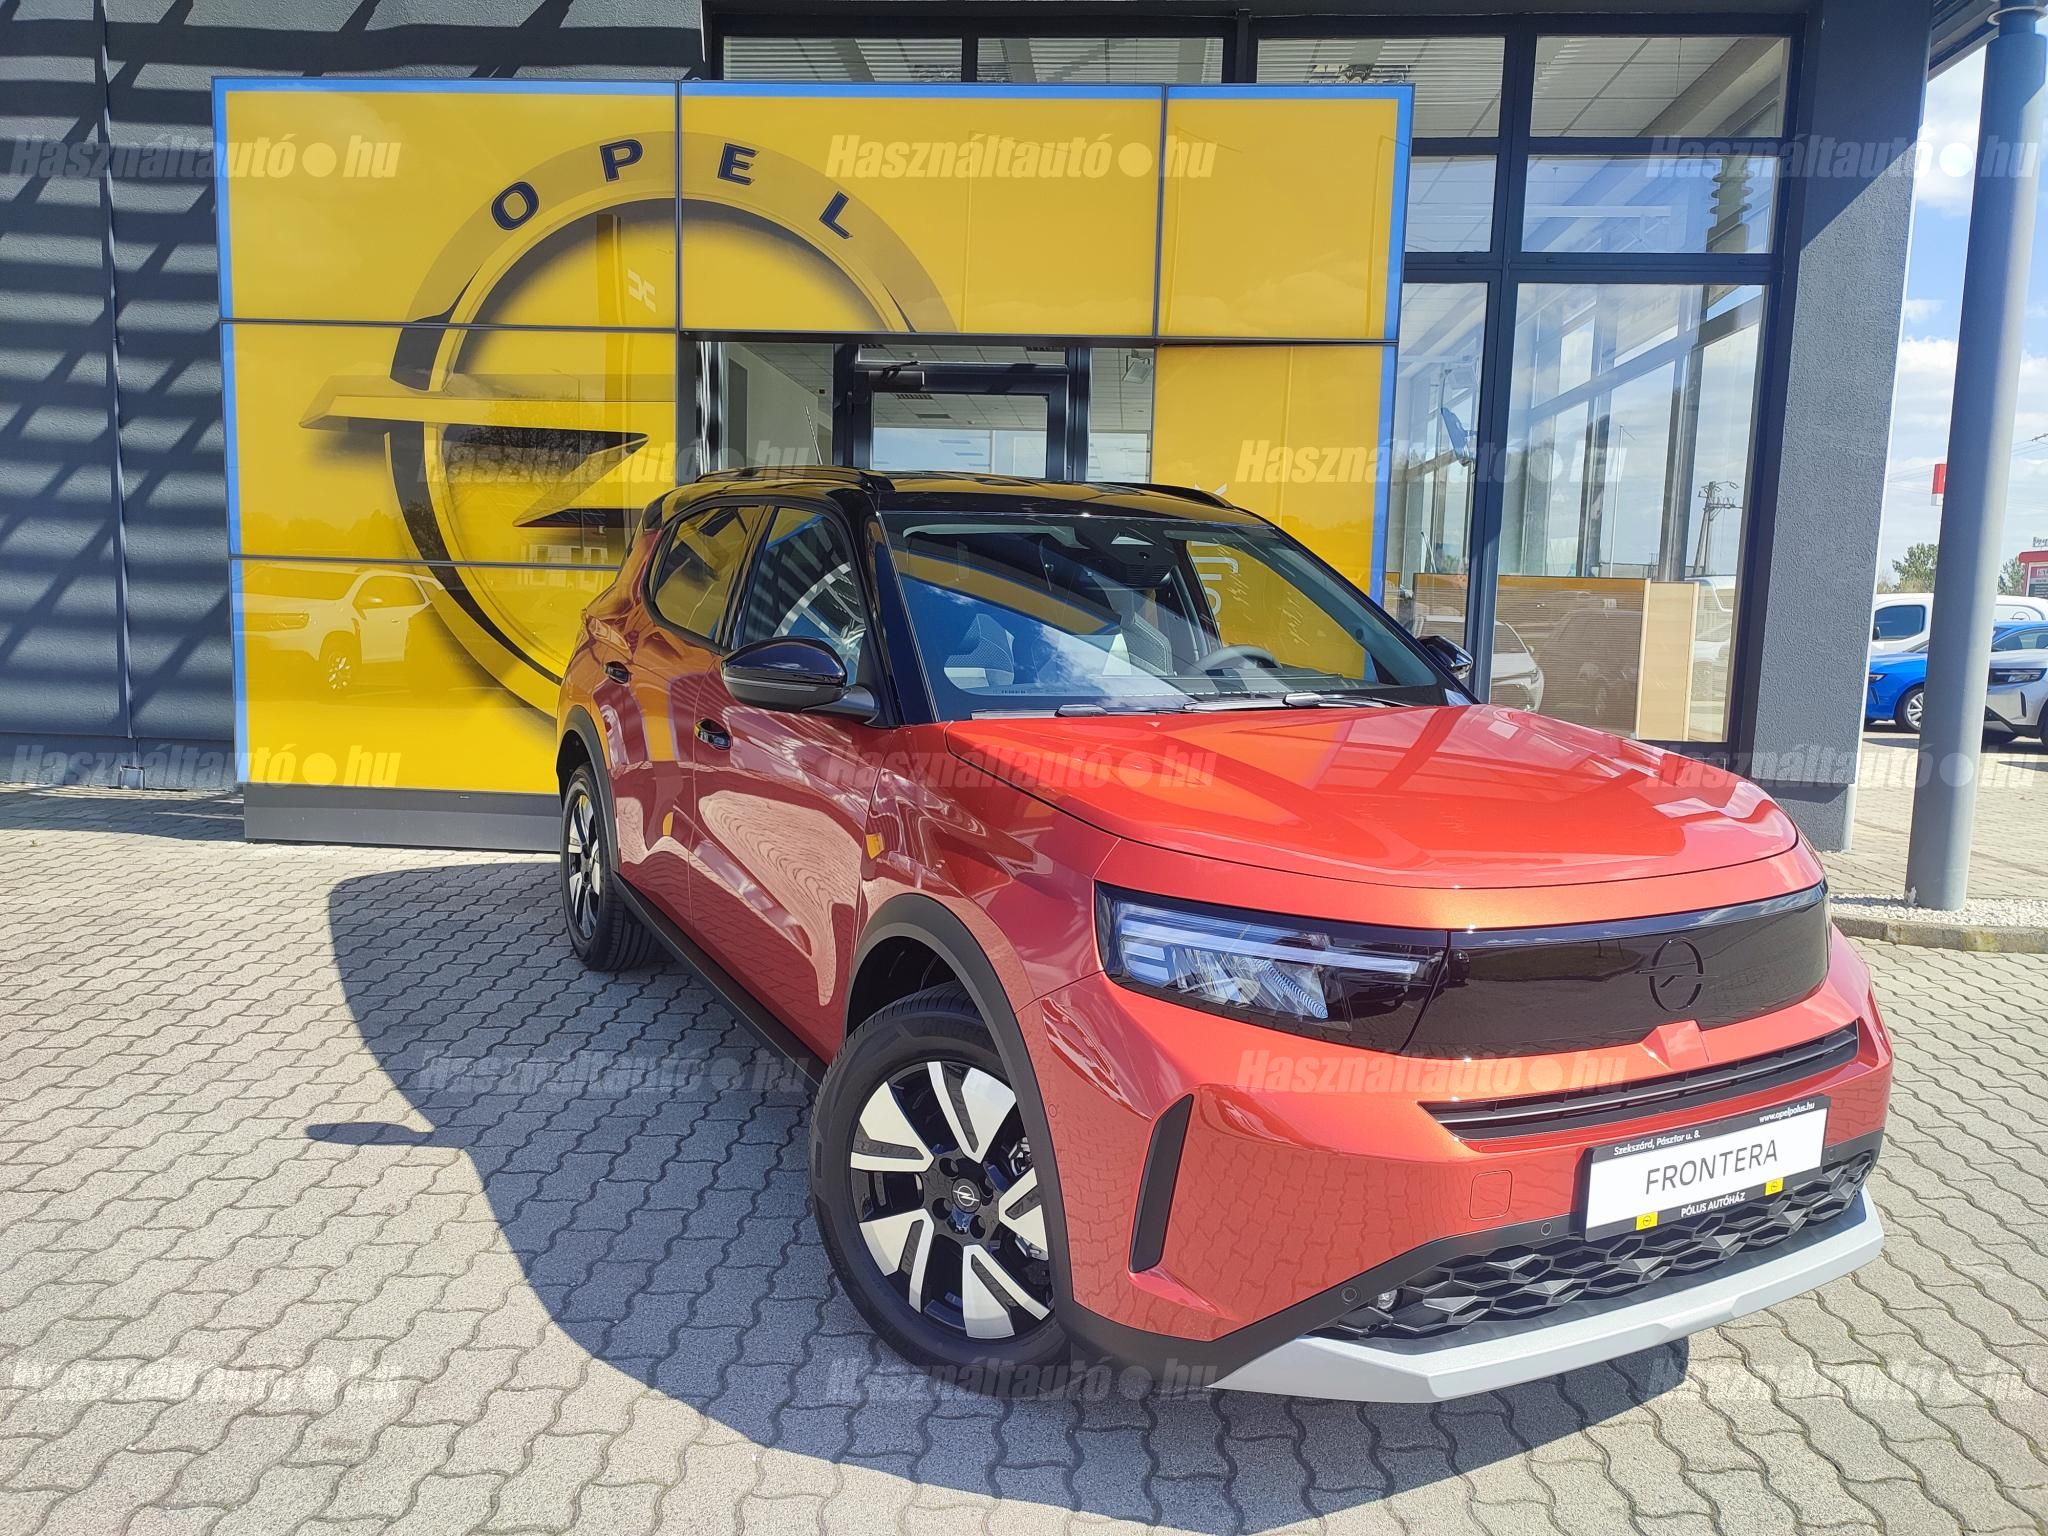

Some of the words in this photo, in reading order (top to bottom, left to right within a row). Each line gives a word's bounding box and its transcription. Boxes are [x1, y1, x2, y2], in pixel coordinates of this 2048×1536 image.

[491, 138, 853, 240] OPEL
[1613, 1138, 1655, 1156] Szekszárd,
[1645, 1139, 1778, 1195] FRONTERA
[1681, 1202, 1708, 1218] PÓLUS
[1708, 1191, 1746, 1211] AUTÓHÁZ
